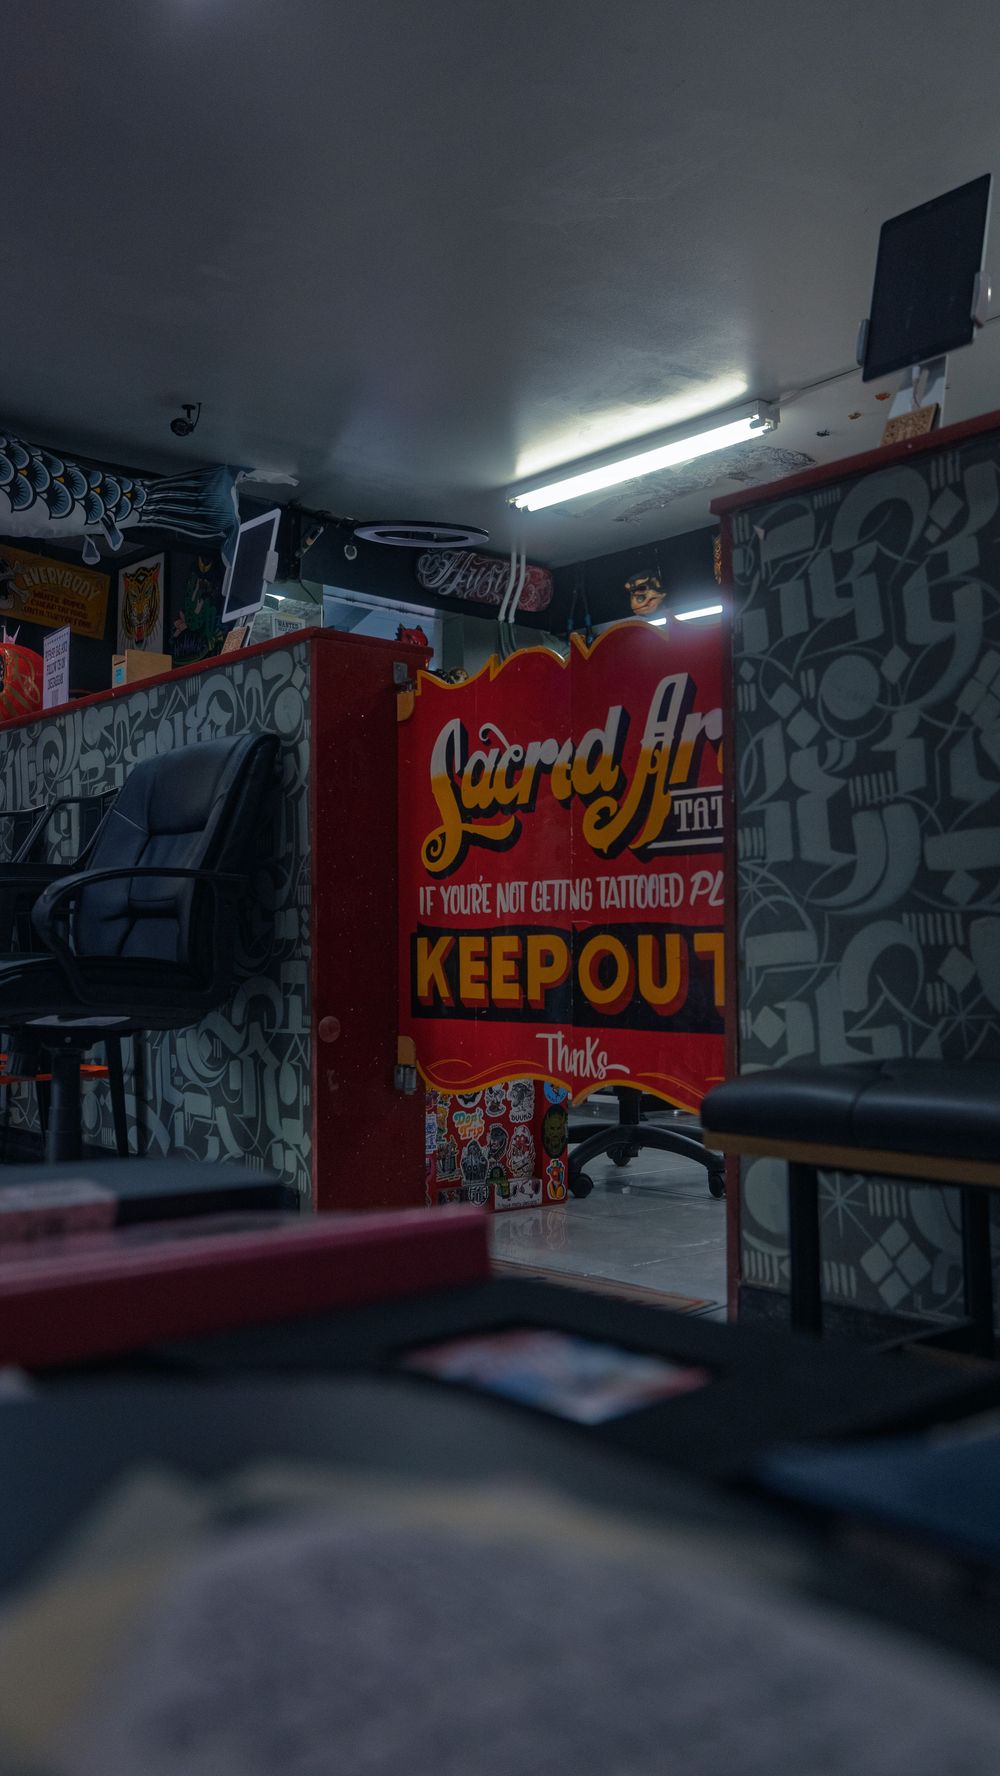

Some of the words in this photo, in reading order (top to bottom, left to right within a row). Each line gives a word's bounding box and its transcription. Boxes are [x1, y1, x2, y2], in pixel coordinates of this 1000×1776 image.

[23, 566, 100, 601] EVERYBODY
[277, 619, 300, 630] WANTED
[421, 705, 624, 874] Sacred
[583, 672, 724, 854] Ar
[419, 886, 436, 916] IF
[496, 881, 529, 919] NOT
[596, 872, 685, 909] TATTOOED
[416, 934, 570, 1006] KEEP
[578, 932, 724, 1007] OUT
[459, 1125, 483, 1138] Trip
